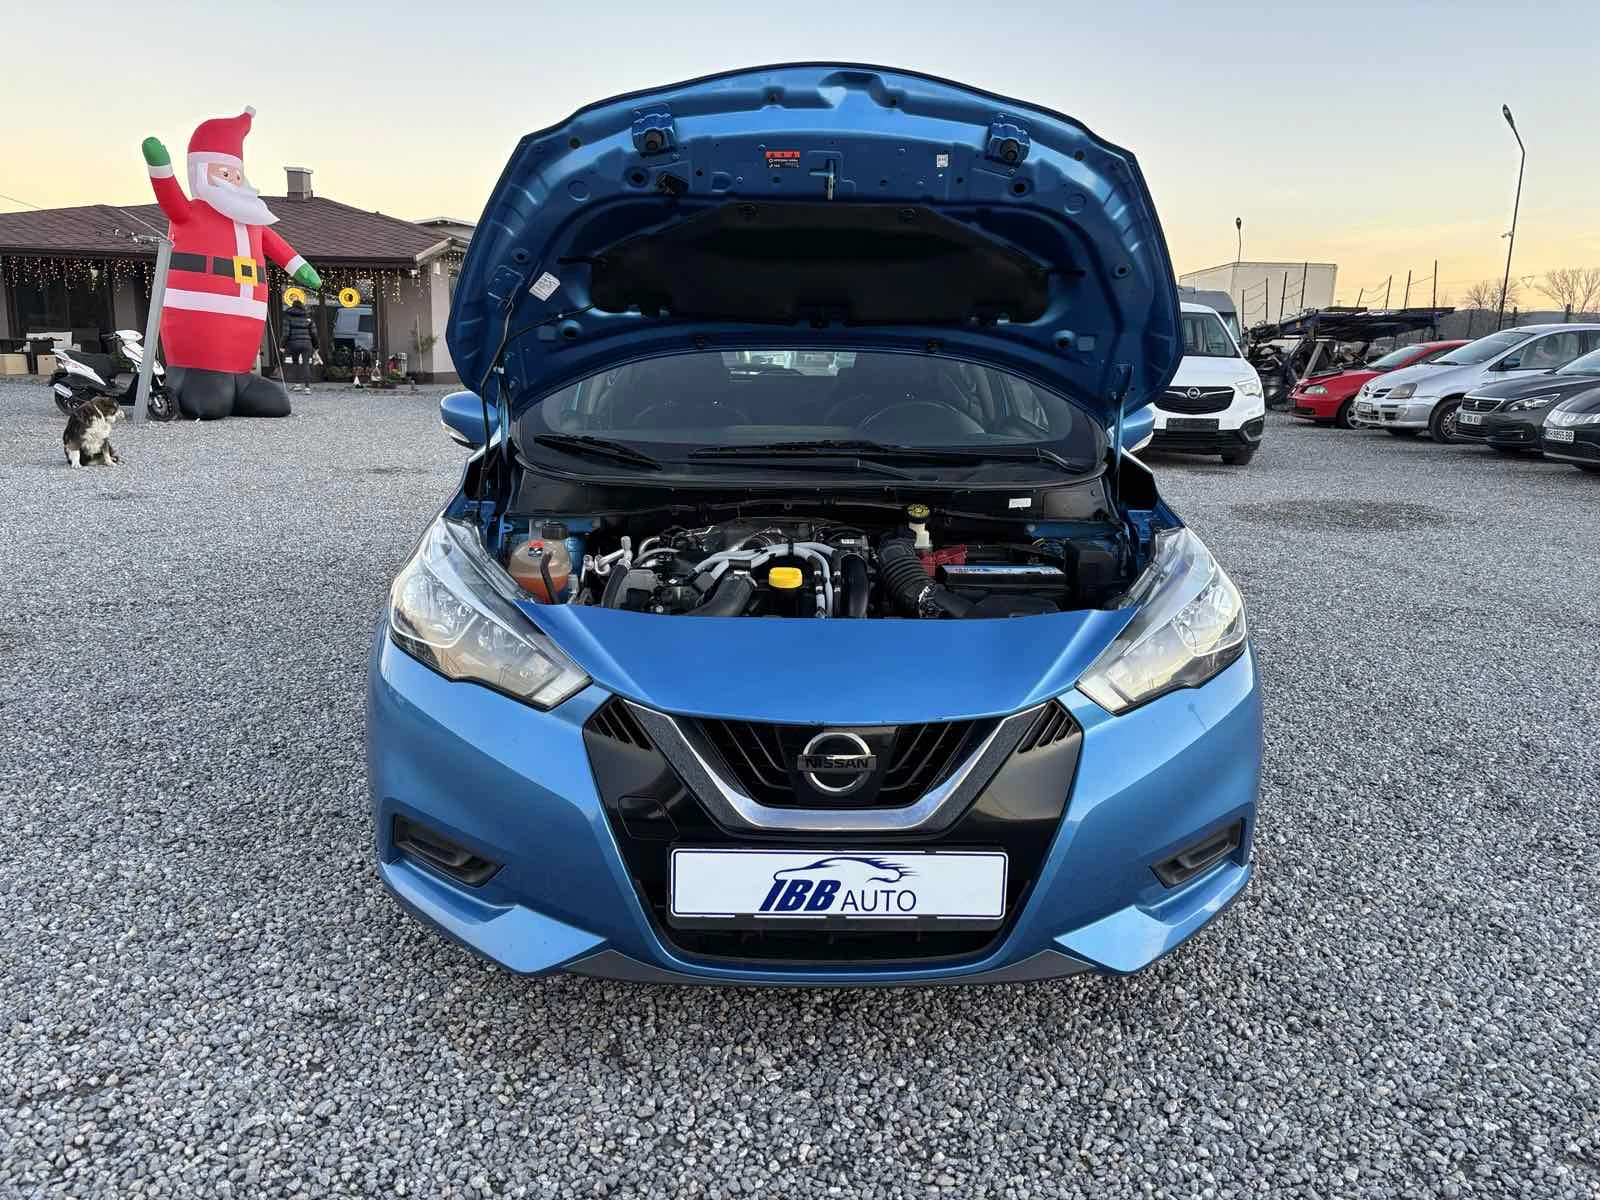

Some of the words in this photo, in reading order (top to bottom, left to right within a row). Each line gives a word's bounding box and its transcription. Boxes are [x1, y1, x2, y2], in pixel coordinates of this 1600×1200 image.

[806, 758, 868, 769] NISSAN
[759, 879, 842, 911] IBB
[840, 890, 917, 911] AUTO
